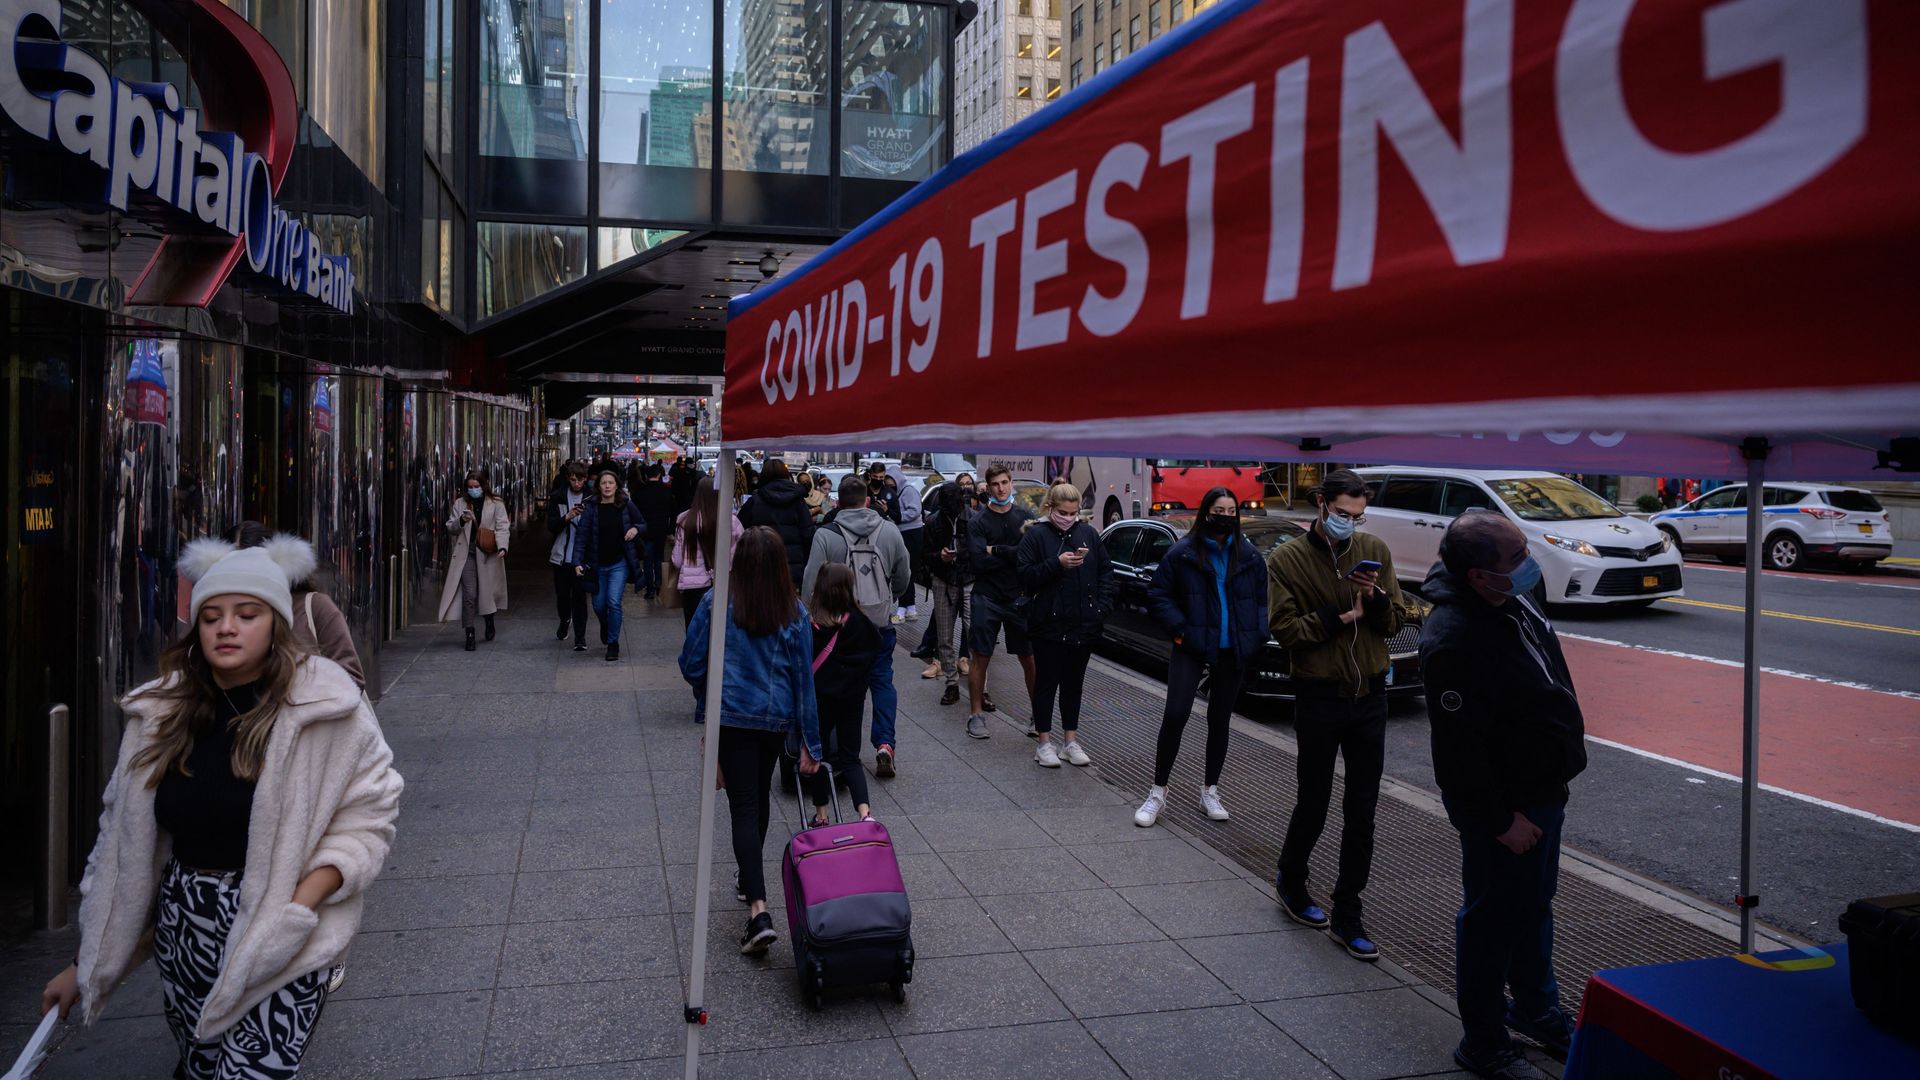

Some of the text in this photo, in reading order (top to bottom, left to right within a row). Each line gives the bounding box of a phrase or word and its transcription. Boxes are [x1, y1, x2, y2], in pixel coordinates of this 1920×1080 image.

[867, 126, 912, 140] HYATT
[867, 139, 912, 152] GRAND
[0, 0, 354, 315] Capital One Bank
[868, 150, 911, 160] CENTRAL
[761, 0, 1868, 405] COVID-19 TESTING
[667, 346, 695, 354] GRAND
[1017, 458, 1033, 472] world
